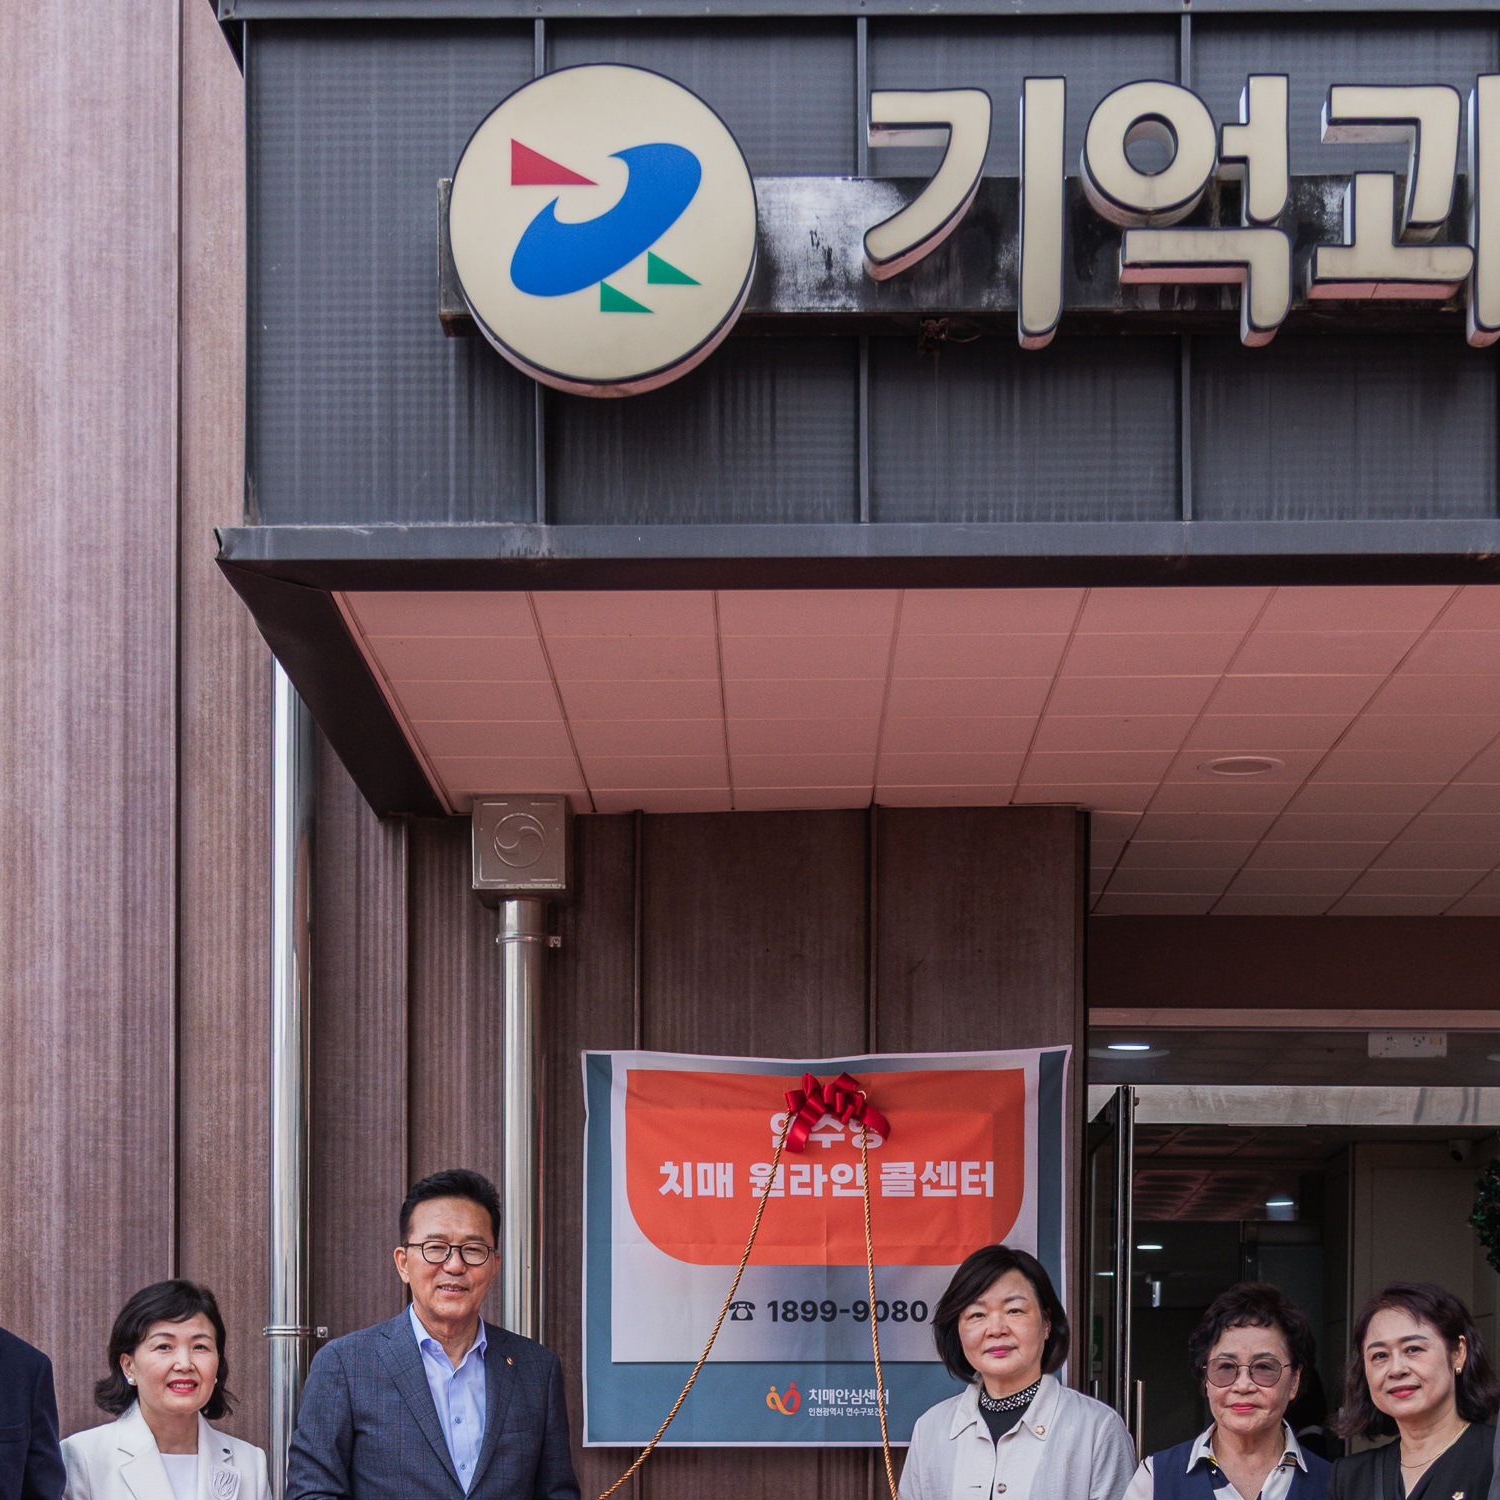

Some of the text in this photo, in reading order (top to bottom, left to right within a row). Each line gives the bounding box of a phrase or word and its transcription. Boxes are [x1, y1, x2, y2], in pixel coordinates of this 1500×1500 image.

[658, 1160, 994, 1198] 치매 원라인 콜센터
[766, 1299, 929, 1323] 1899-9080
[808, 1388, 889, 1405] 치매안심센터
[808, 1407, 844, 1417] 인천광역시
